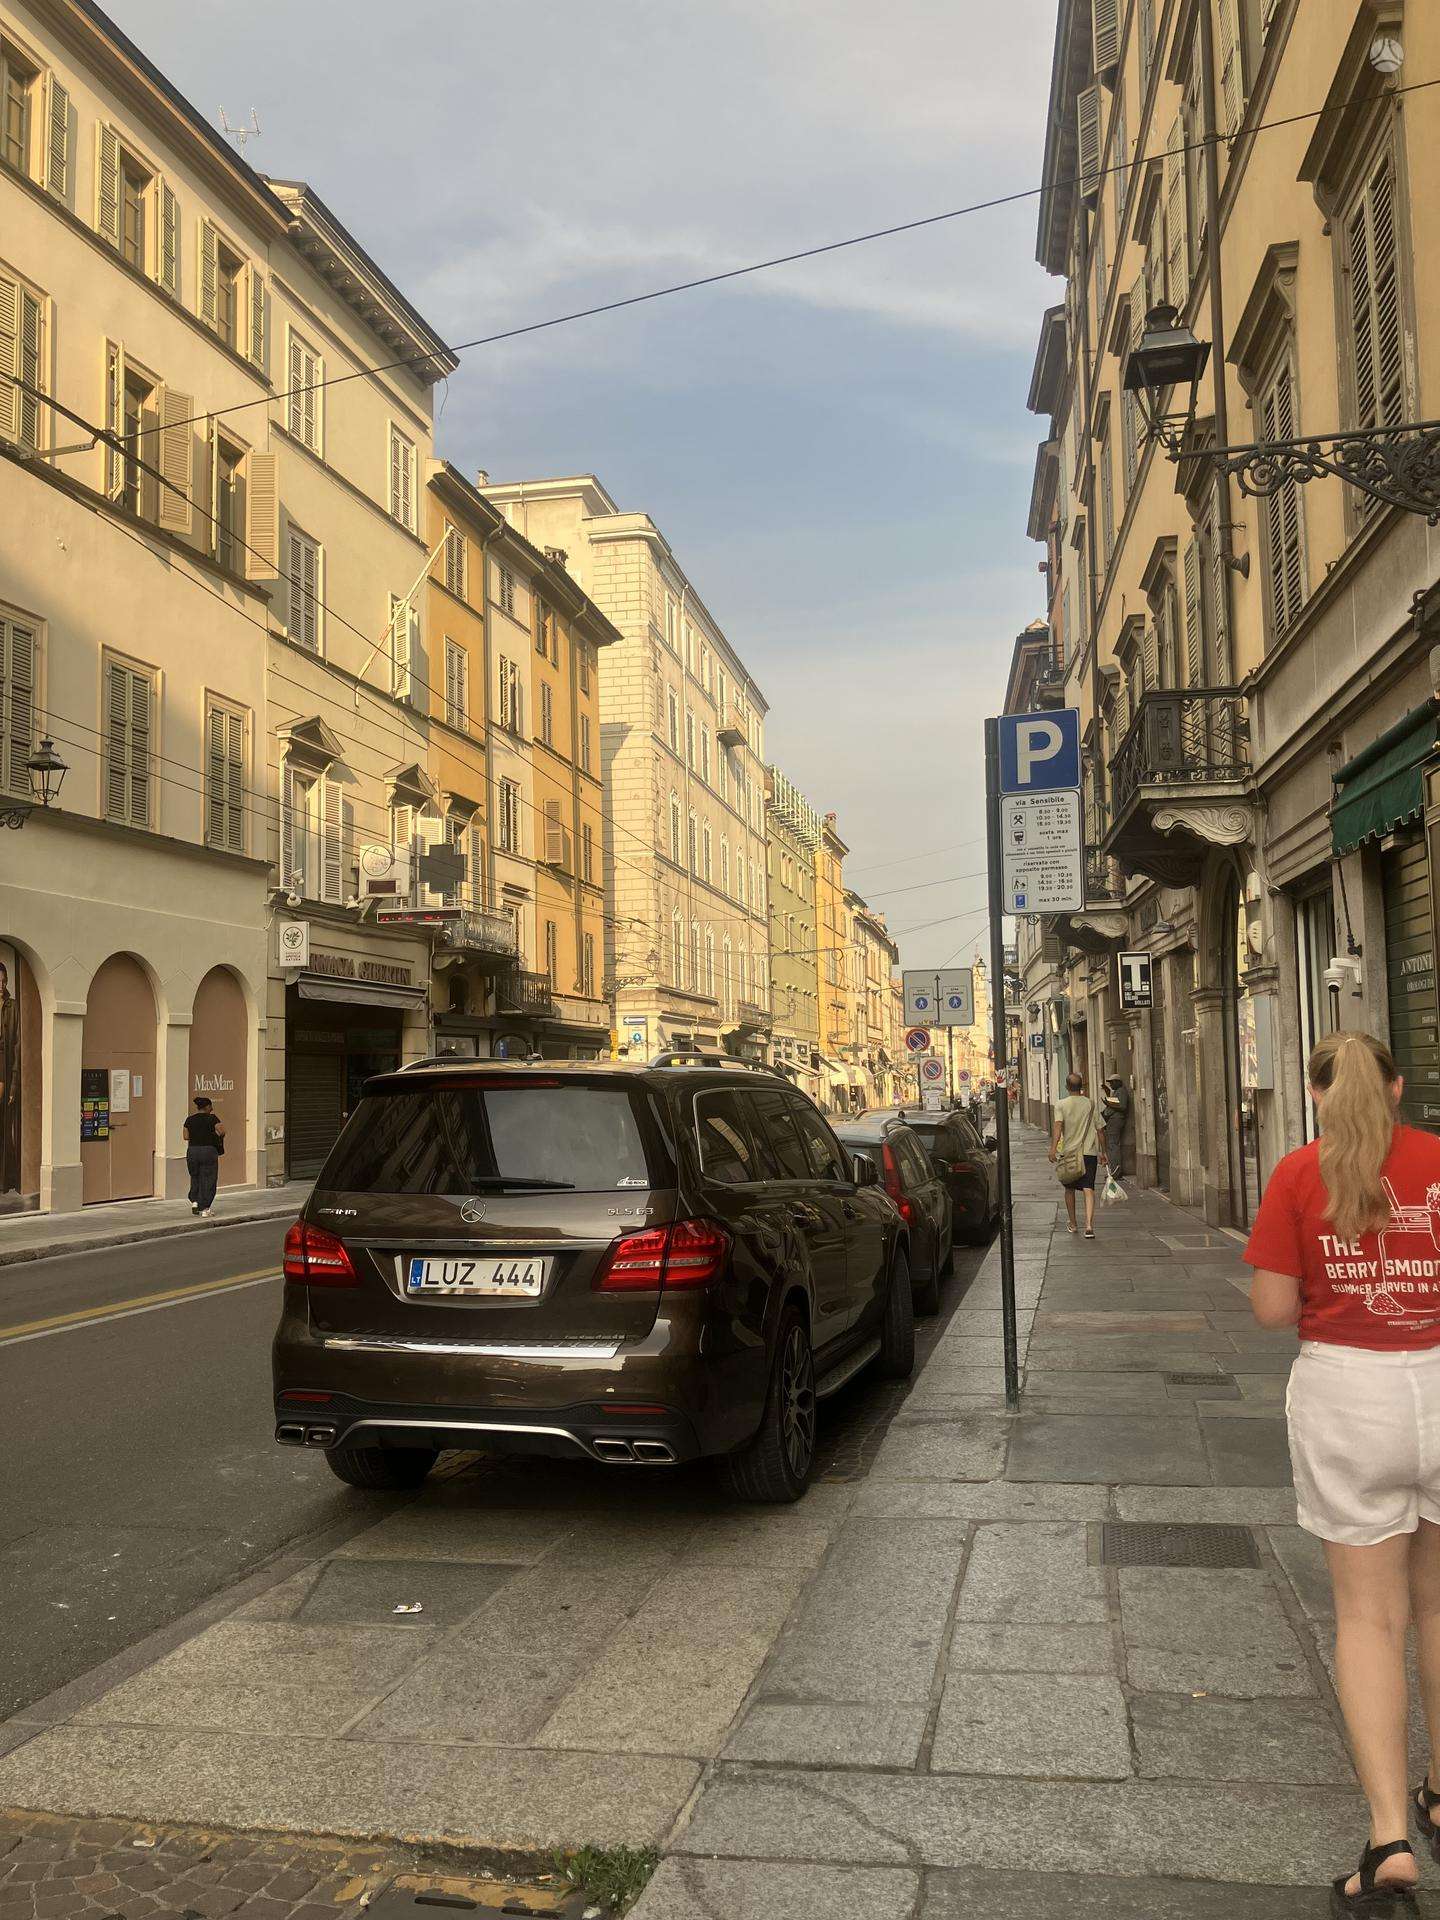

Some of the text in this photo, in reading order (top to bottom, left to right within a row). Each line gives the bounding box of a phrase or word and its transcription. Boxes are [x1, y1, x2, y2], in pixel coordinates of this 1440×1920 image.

[1016, 719, 1064, 785] P
[1030, 796, 1065, 805] Sensibile
[1122, 955, 1149, 991] T
[1034, 1035, 1043, 1047] P
[194, 1073, 234, 1092] MaxMara
[607, 1207, 654, 1216] GLS 63
[1317, 1232, 1364, 1258] THE
[424, 1262, 536, 1287] LUZ 444
[1324, 1260, 1378, 1280] BERRY
[411, 1276, 421, 1284] LT
[1331, 1283, 1373, 1295] SUMMER
[1374, 1281, 1415, 1294] SERVED
[1417, 1282, 1430, 1294] IN
